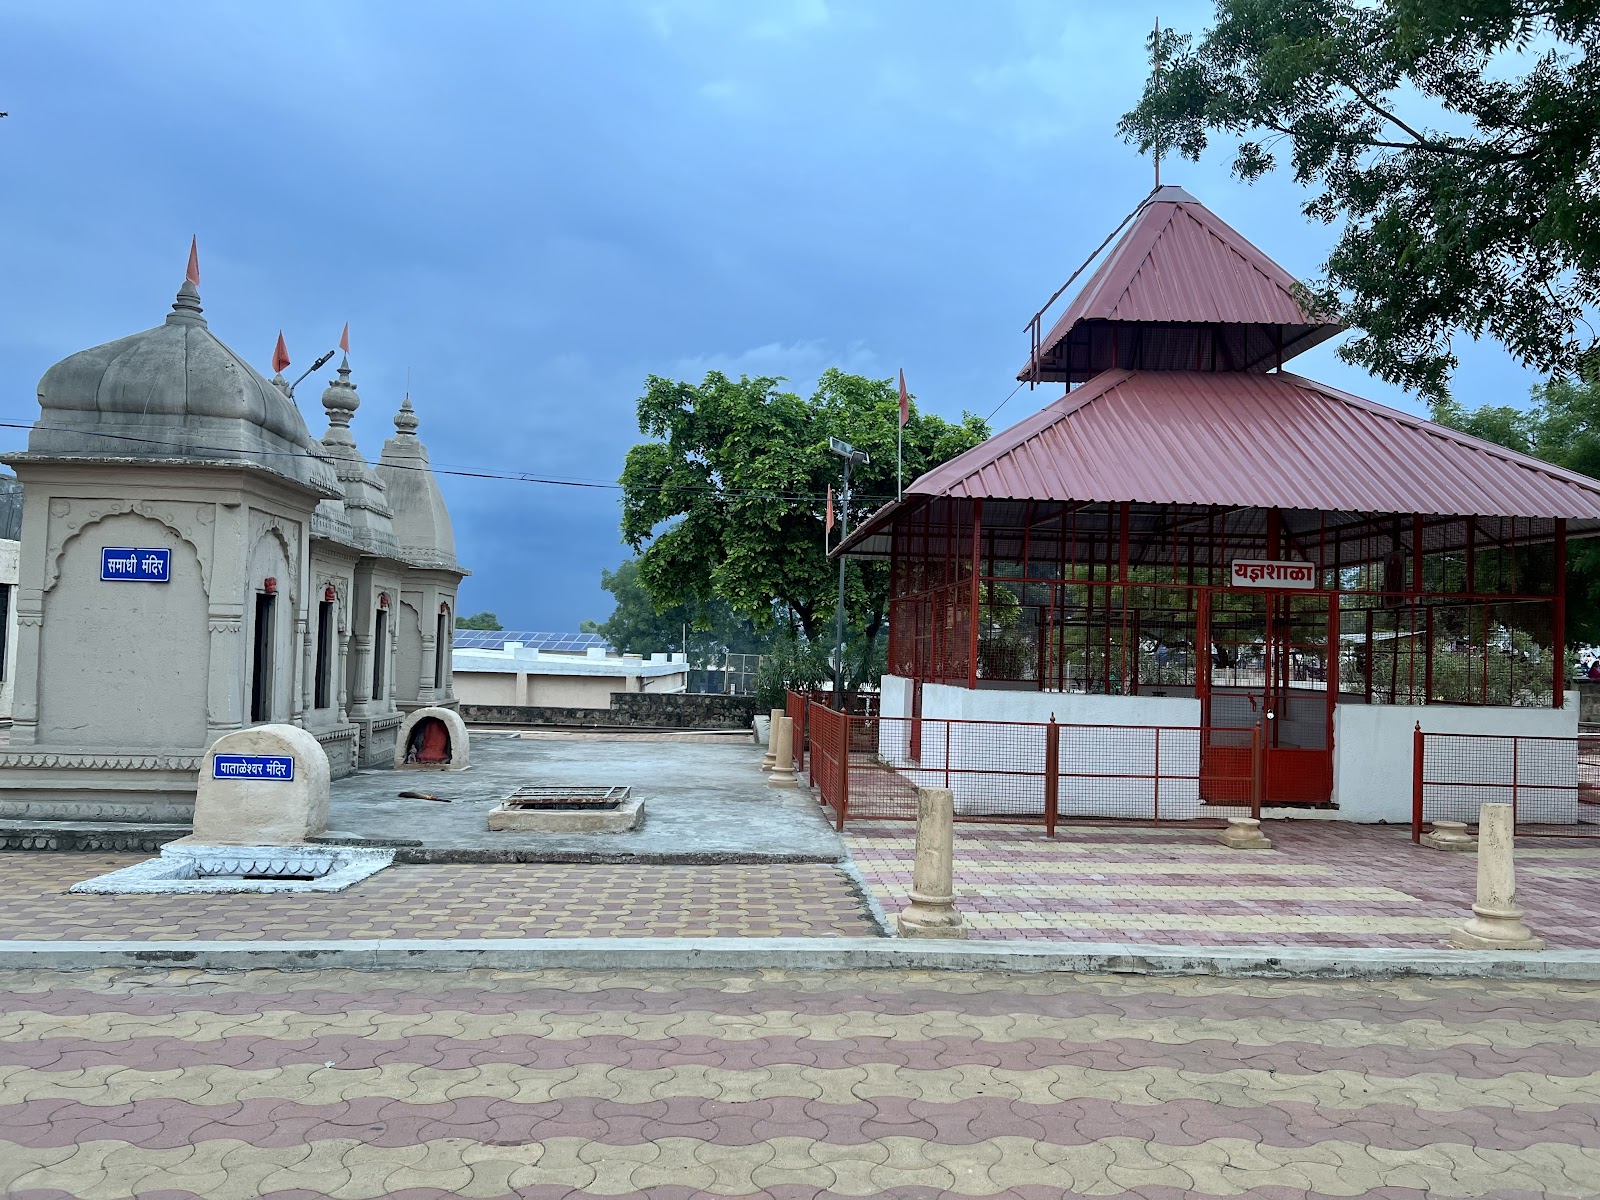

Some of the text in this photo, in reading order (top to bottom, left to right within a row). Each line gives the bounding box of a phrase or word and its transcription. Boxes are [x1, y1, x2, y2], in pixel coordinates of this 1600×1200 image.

[107, 554, 164, 575] समाधी मंदिर
[1234, 564, 1313, 583] यज्ञशाळा
[220, 759, 287, 776] पाताळेश्वर मंदिर
